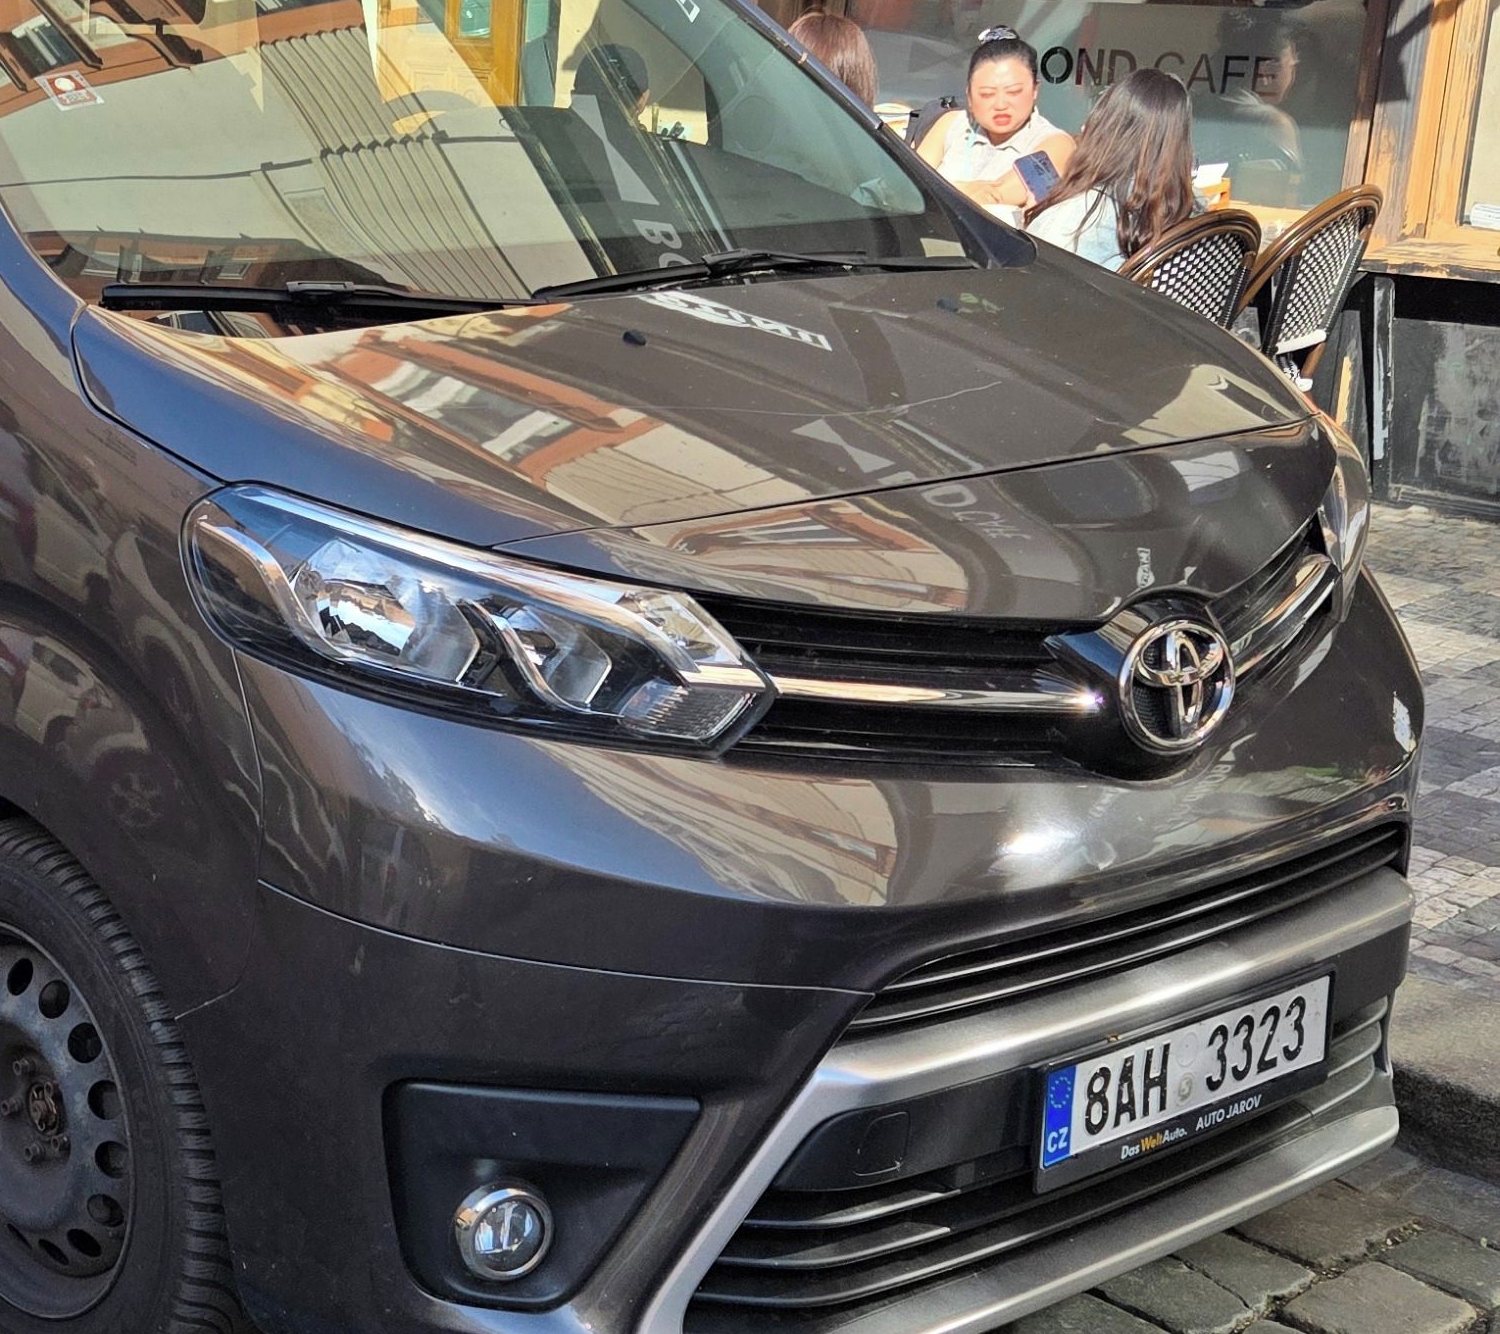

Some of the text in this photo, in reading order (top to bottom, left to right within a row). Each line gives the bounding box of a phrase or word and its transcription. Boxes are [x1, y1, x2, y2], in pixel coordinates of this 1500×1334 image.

[1038, 45, 1137, 87] OND
[1084, 995, 1307, 1136] 8AH 3323
[1047, 1126, 1069, 1154] CZ
[1120, 1144, 1140, 1160] Das
[1195, 1110, 1225, 1132] AUTO
[1226, 1094, 1263, 1119] JAROV
